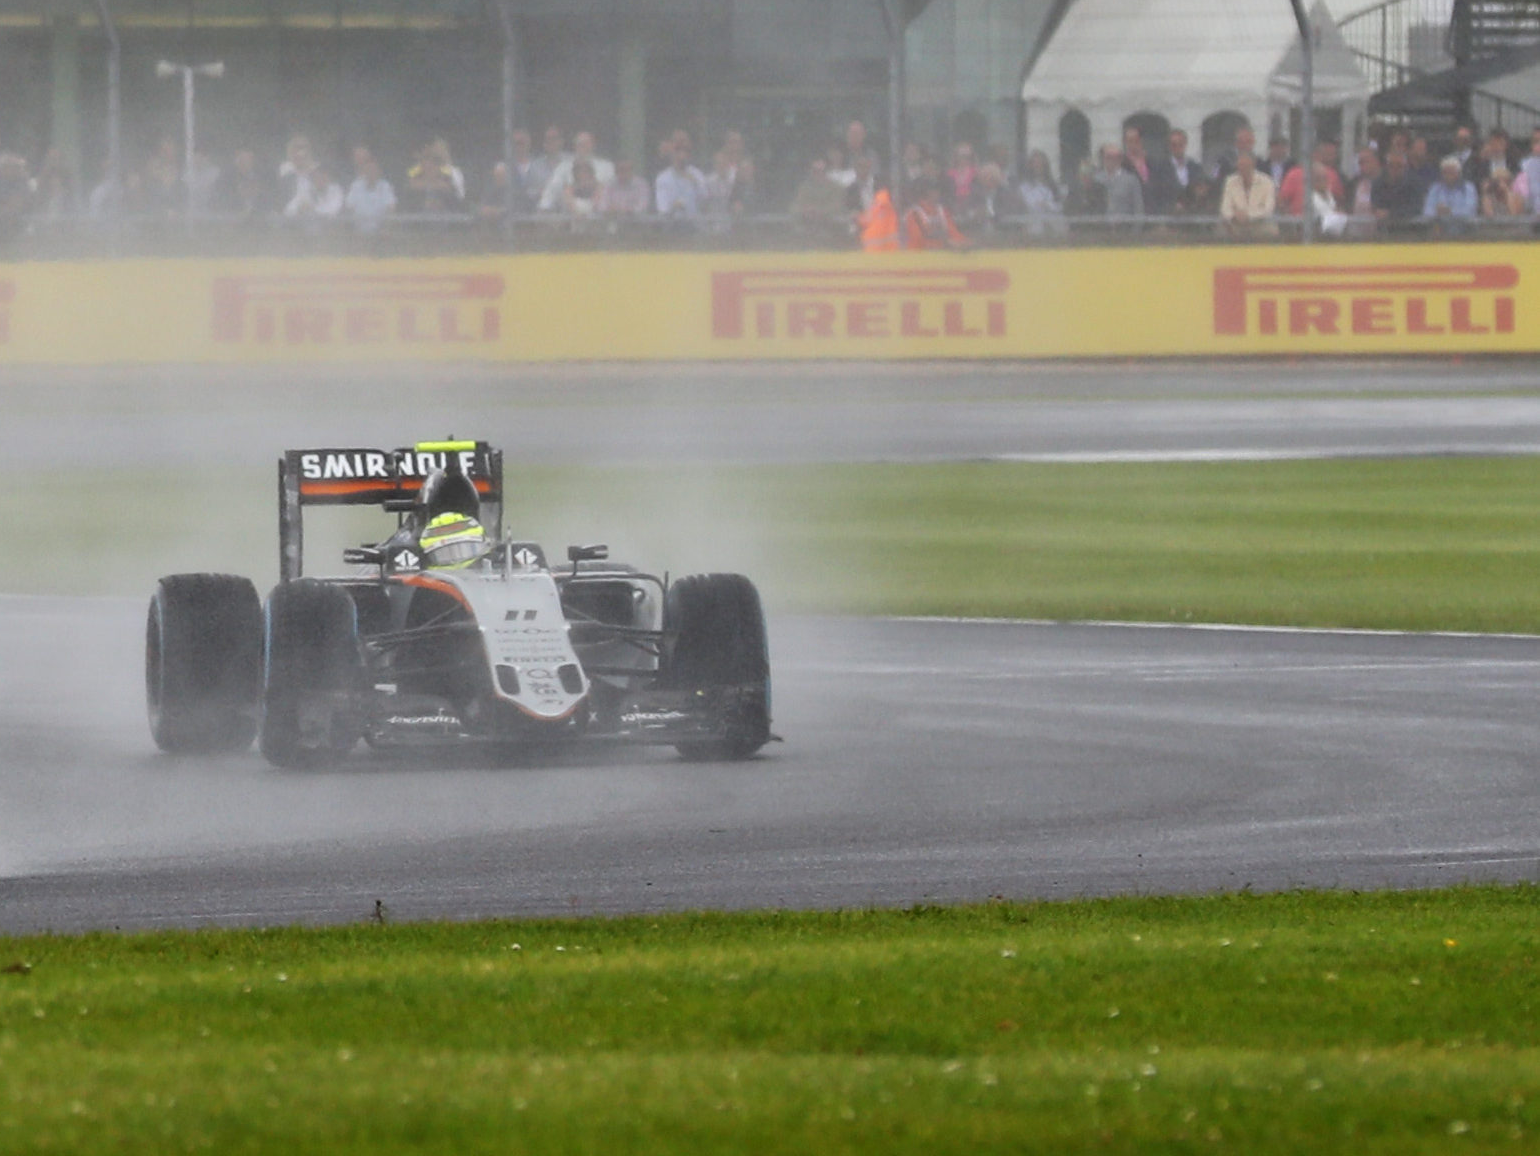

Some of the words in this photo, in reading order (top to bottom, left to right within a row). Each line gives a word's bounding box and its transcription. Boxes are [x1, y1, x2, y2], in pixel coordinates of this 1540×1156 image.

[211, 273, 504, 343] PIRELLI
[712, 269, 1009, 339] PIRELLI
[1213, 264, 1519, 336] PIRELLI
[301, 452, 475, 479] SMIRNOF
